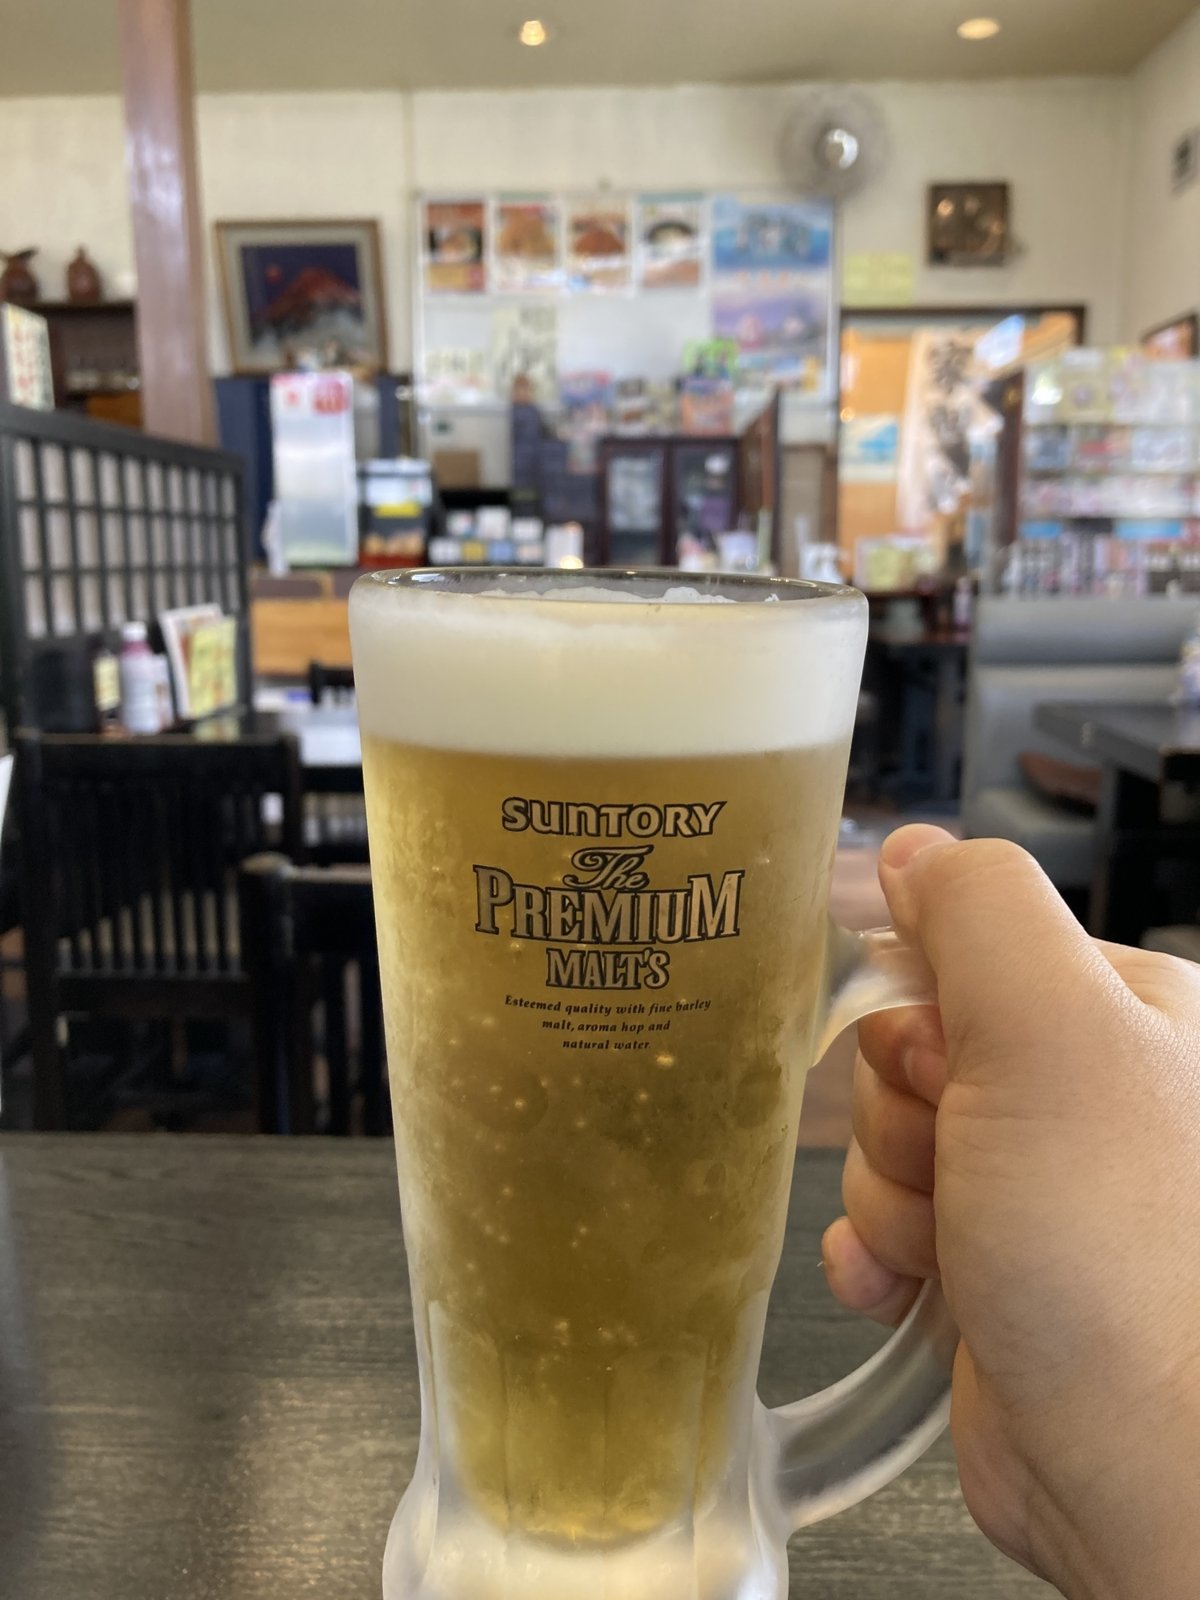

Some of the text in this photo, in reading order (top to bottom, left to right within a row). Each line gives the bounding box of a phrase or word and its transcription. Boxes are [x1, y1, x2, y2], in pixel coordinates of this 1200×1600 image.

[563, 845, 654, 890] The
[473, 864, 746, 945] PREMIUM
[546, 947, 670, 990] MALT'S
[505, 995, 711, 1016] Esteemed quality with fine barley
[542, 1020, 671, 1035] malt, aroma hop and
[563, 1040, 609, 1050] natural
